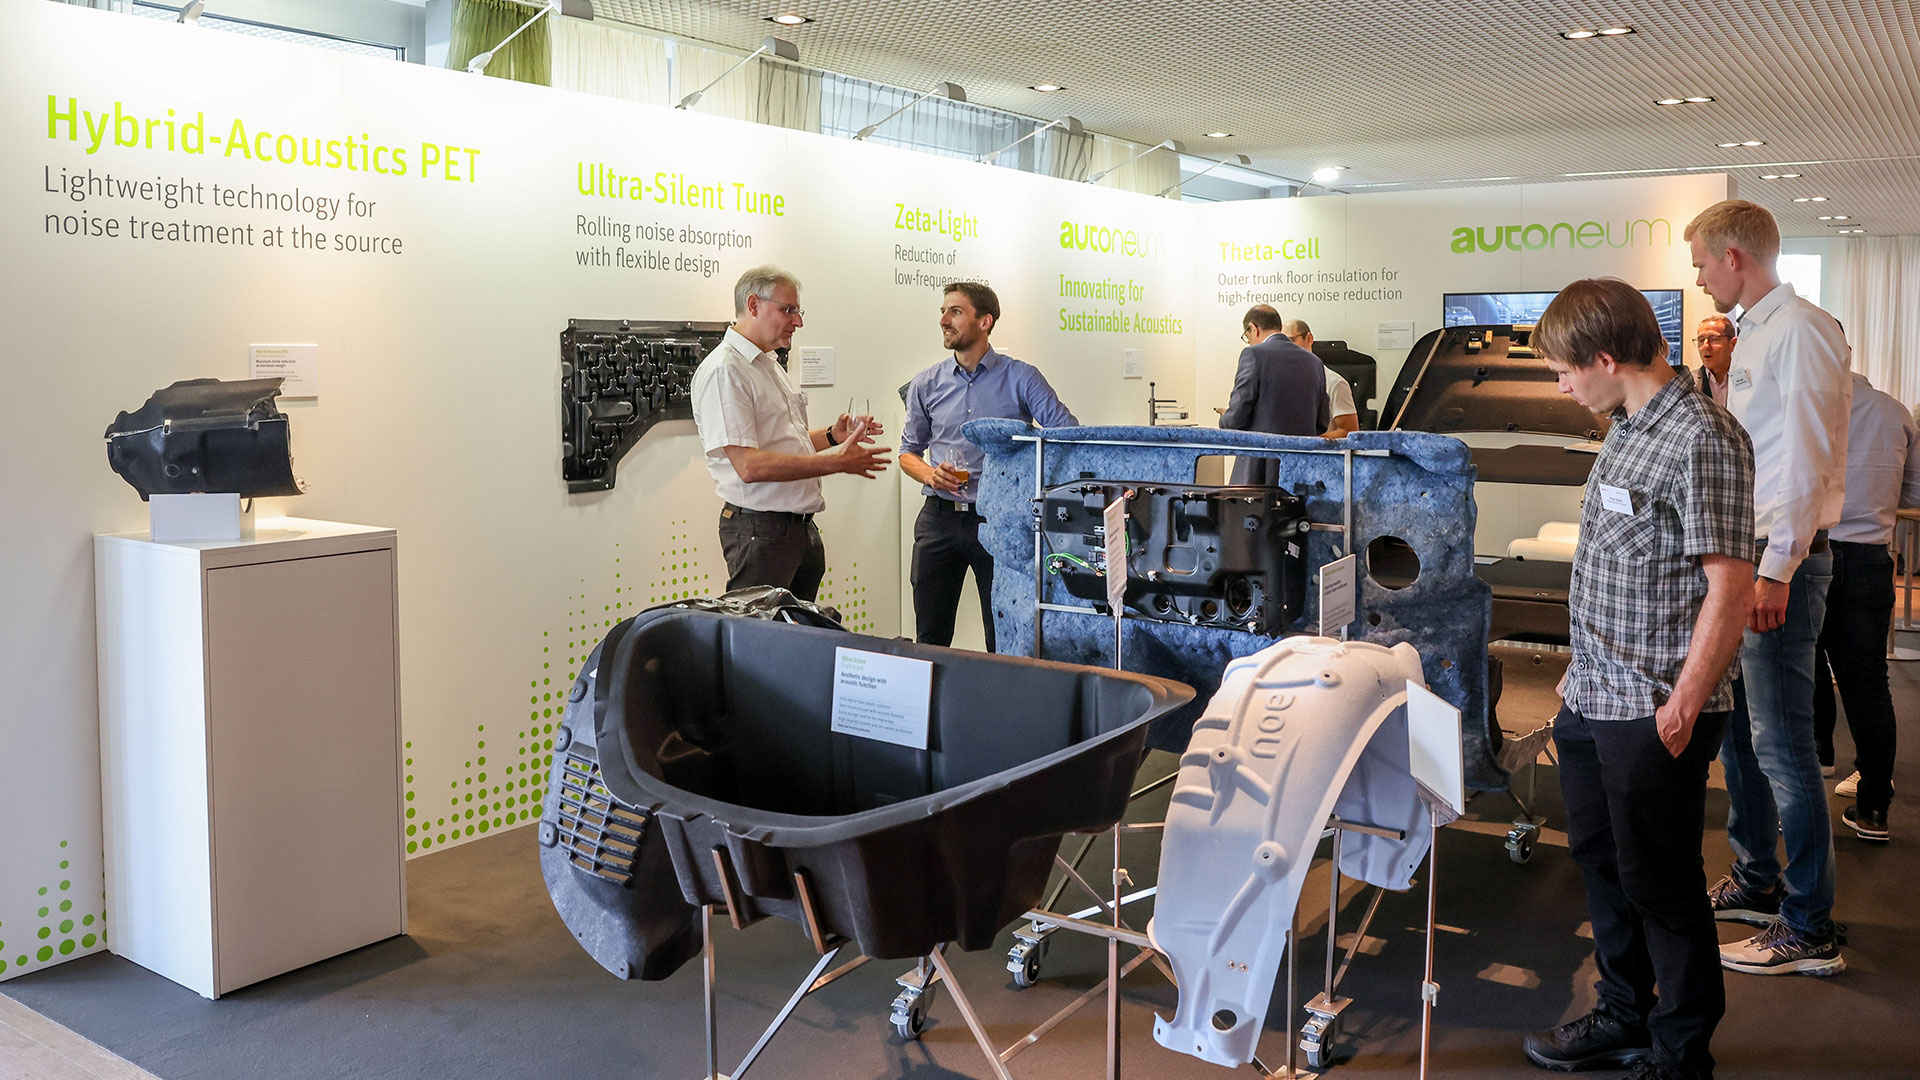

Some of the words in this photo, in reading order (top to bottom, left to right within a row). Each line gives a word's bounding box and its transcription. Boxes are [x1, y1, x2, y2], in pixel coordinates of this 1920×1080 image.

[47, 94, 408, 176] Hybrid-Acoustics
[421, 142, 481, 183] PET
[45, 165, 204, 209] Lightweight
[213, 183, 341, 221] technology
[347, 193, 376, 218] for
[577, 162, 725, 211] Ultra-Silent
[732, 182, 785, 217] Tune
[45, 210, 120, 238] noise
[129, 215, 254, 246] treatment
[262, 226, 284, 247] at
[291, 225, 326, 250] the
[334, 232, 403, 255] source
[576, 215, 631, 243] Rolling
[636, 222, 675, 242] noise
[679, 224, 752, 250] absorption
[895, 203, 978, 242] Zeta-Light
[1451, 219, 1671, 254] autoneum
[895, 244, 944, 265] Reduction
[947, 249, 956, 265] of
[1060, 221, 1167, 258] autoneum
[1219, 238, 1320, 262] Theta-Cell
[576, 247, 611, 267] with
[616, 247, 670, 271] flexible
[674, 253, 720, 278] design
[1218, 272, 1249, 286] Outer
[1252, 271, 1283, 285] trunk
[1286, 270, 1313, 284] floor
[1317, 269, 1378, 283] insulation
[1381, 267, 1399, 281] for
[1059, 274, 1125, 306] Innovating
[1128, 279, 1144, 302] for
[1218, 289, 1304, 307] high-frequency
[1307, 290, 1339, 302] noise
[1343, 287, 1402, 301] reduction
[1059, 308, 1130, 334] Sustainable
[1134, 312, 1183, 334] Acoustics
[841, 671, 860, 680] Aesthetic
[861, 675, 876, 683] design
[859, 681, 877, 690] function
